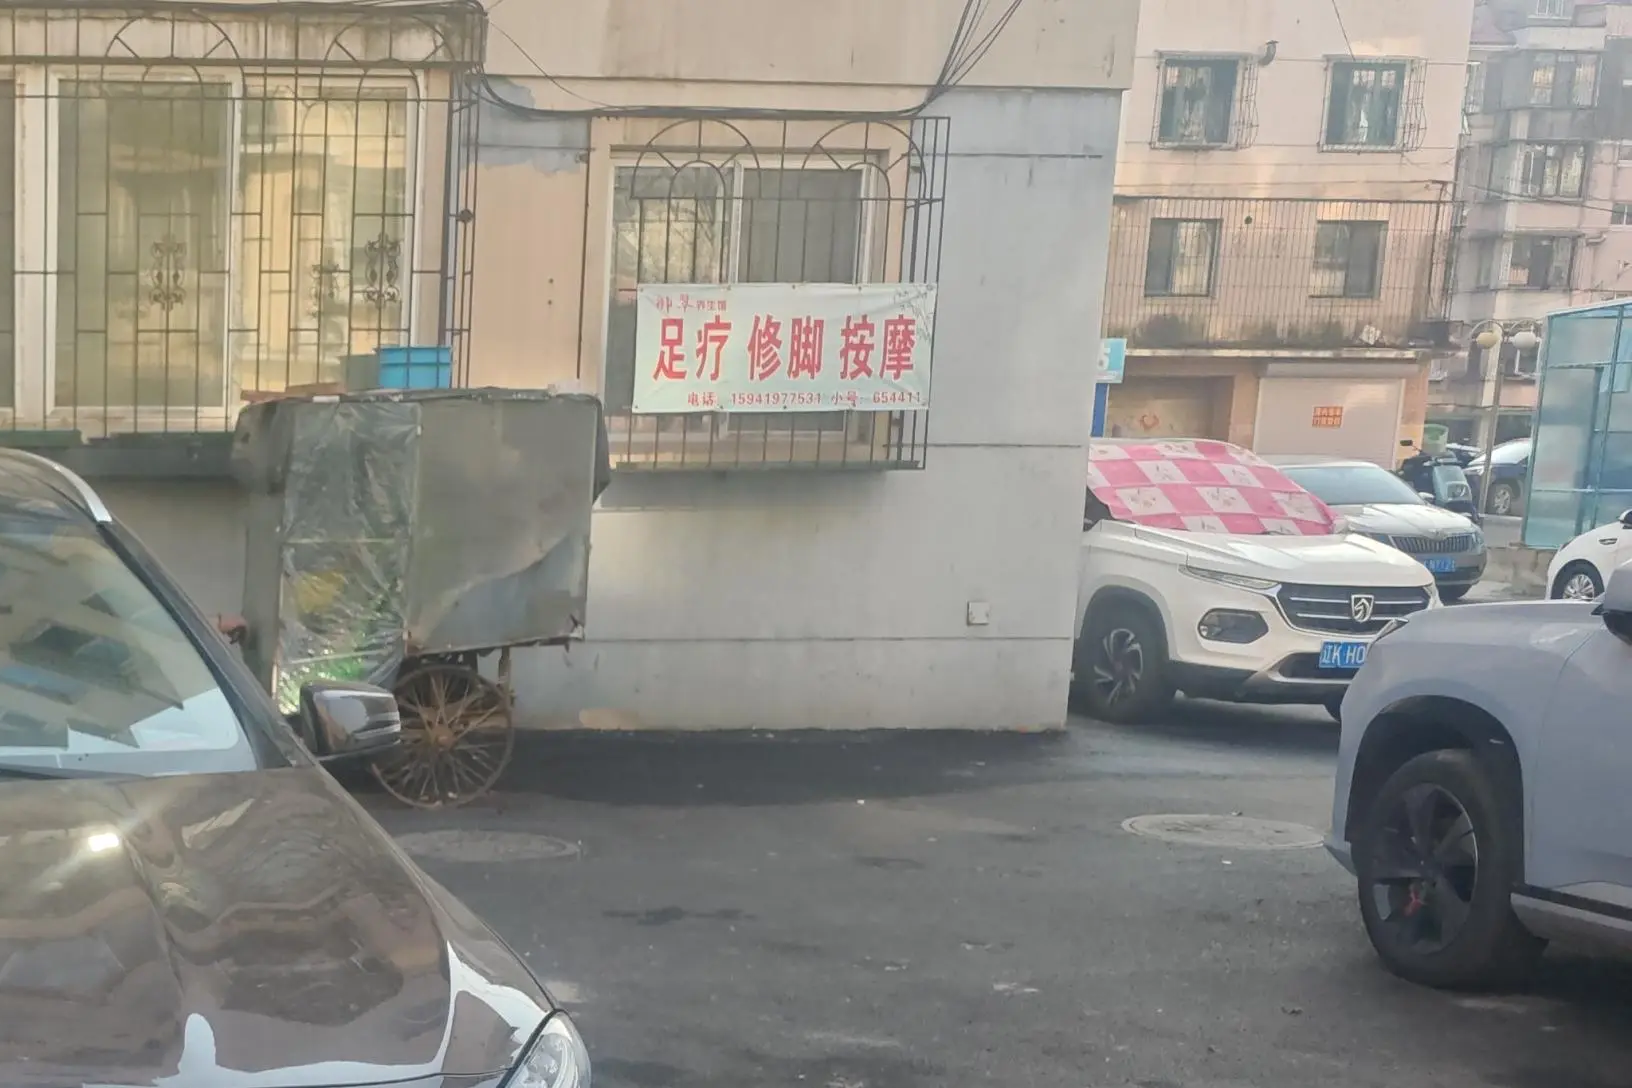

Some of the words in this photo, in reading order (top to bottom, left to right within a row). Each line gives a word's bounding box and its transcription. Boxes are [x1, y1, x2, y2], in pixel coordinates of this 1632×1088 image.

[652, 314, 732, 381] 足疗
[747, 314, 825, 381] 修脚
[839, 314, 916, 381] 按摩
